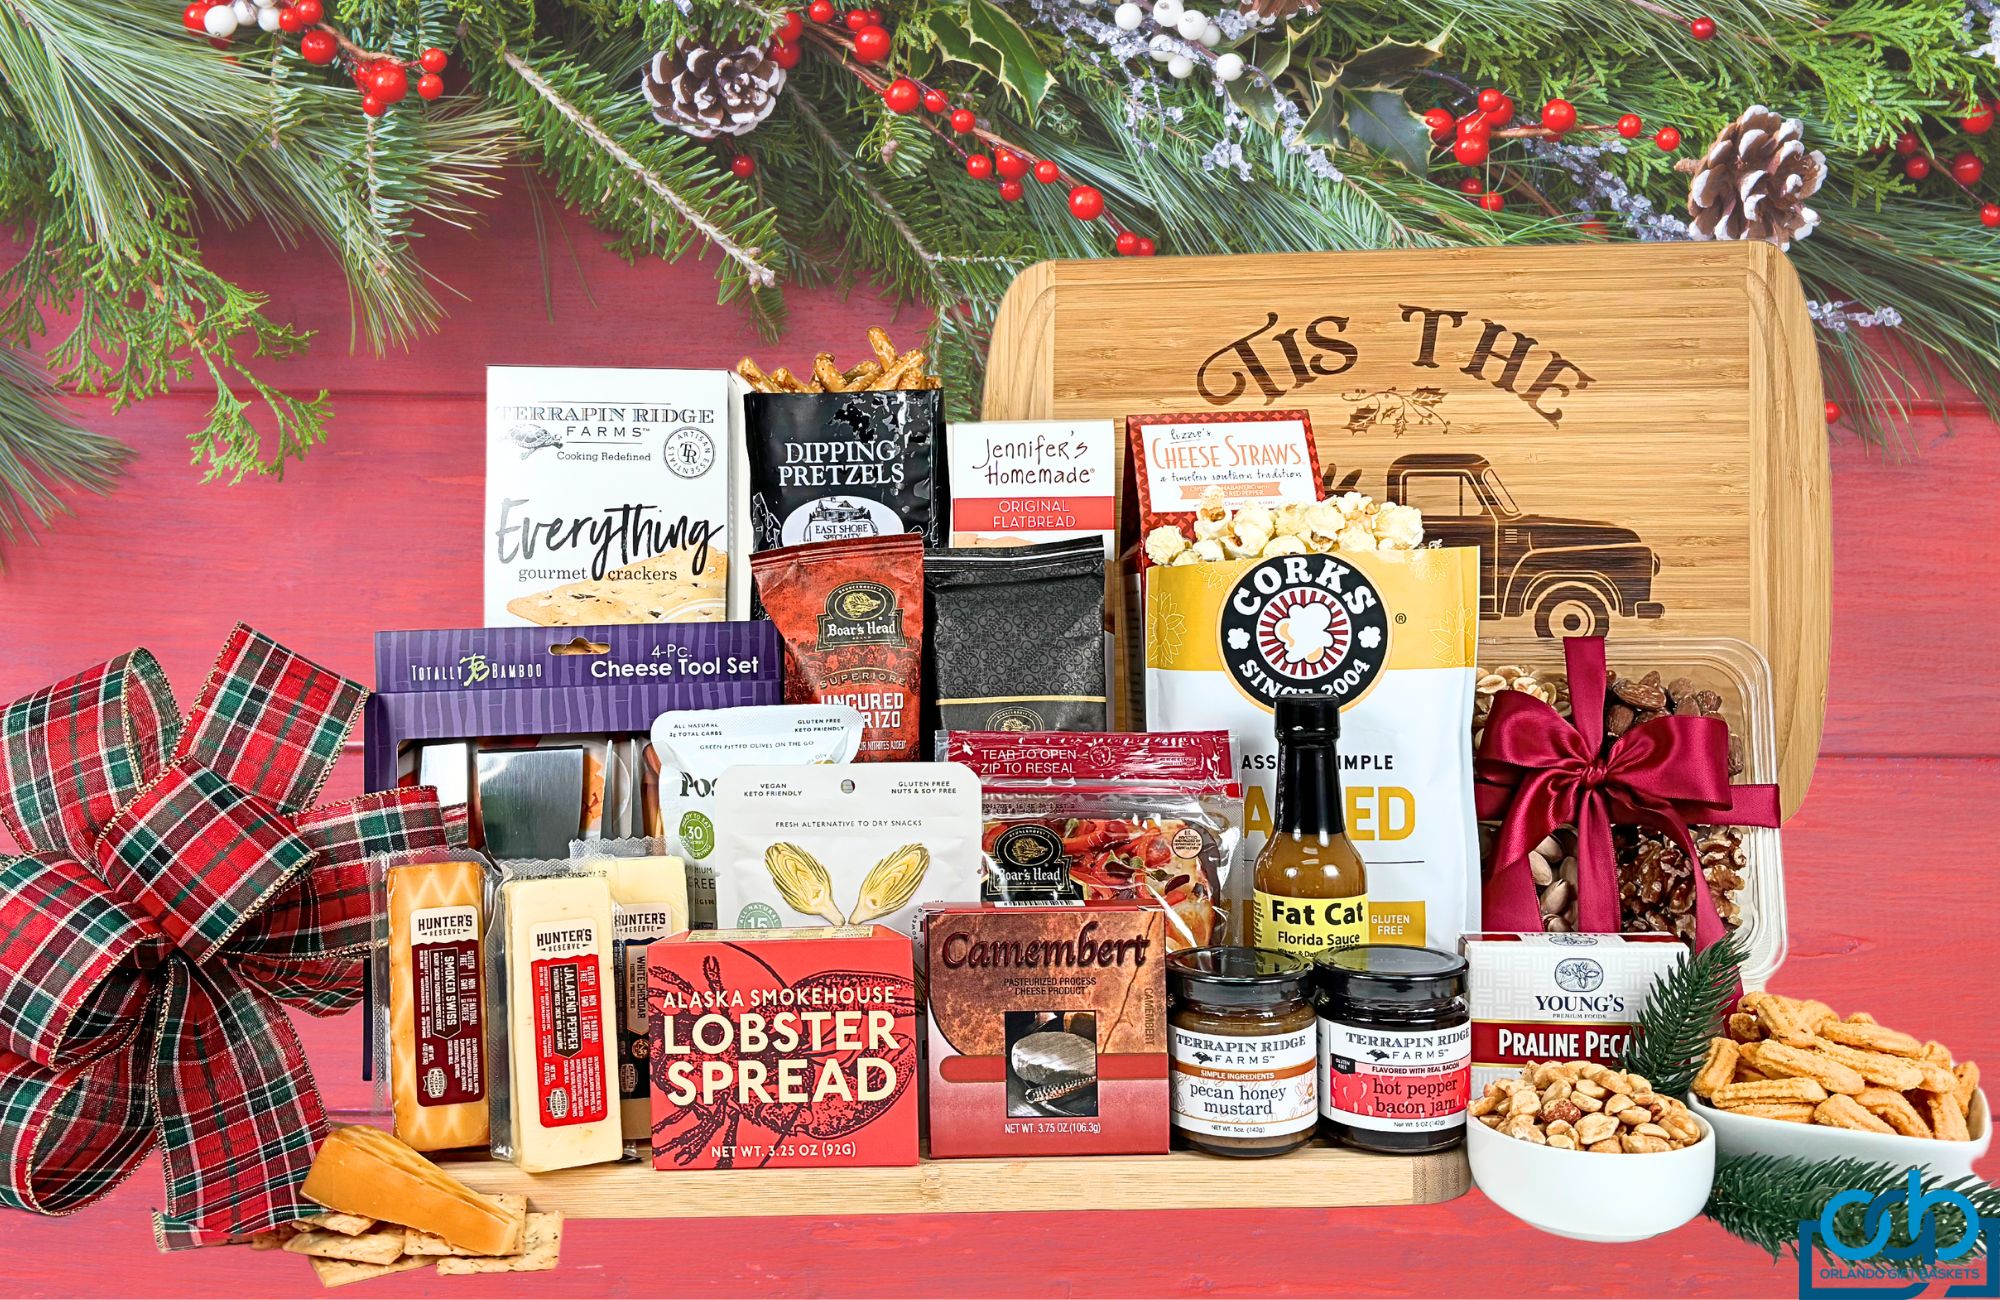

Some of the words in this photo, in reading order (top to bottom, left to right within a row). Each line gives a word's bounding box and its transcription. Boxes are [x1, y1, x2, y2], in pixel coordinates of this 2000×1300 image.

[1398, 303, 1598, 430] THE
[496, 407, 626, 422] TERRAPIN
[632, 408, 714, 423] RIDGE
[676, 431, 711, 454] ARTISAN
[972, 429, 1088, 469] Jennifer's
[557, 451, 598, 462] Cooking
[601, 452, 651, 462] Redefined
[667, 445, 710, 475] ESSENTIALS
[784, 440, 896, 464] DIPPING
[778, 463, 905, 487] PRETZELS
[999, 500, 1069, 513] ORIGINAL
[815, 525, 837, 534] EAST
[839, 524, 868, 533] SHORE
[993, 516, 1076, 529] FLATBREAD
[496, 499, 724, 582] Everything
[518, 567, 588, 582] gourmet
[607, 566, 678, 581] crackers
[1233, 557, 1377, 615] CORKS
[827, 623, 865, 637] Boar's
[866, 620, 896, 635] Head
[651, 644, 692, 660] 4-Pc.
[411, 665, 462, 682] TOTALLY
[492, 663, 542, 680] BAMBOO
[590, 660, 672, 679] Cheese
[678, 658, 721, 676] Tool
[727, 656, 759, 675] Set
[819, 671, 906, 689] SUPERIORE
[820, 693, 904, 710] UNCURED
[981, 750, 1016, 760] TEAR
[1020, 750, 1037, 760] TO
[1039, 750, 1077, 760] OPEN
[980, 763, 1001, 774] ZIP
[1006, 763, 1023, 774] TO
[1025, 762, 1077, 774] RESEAL
[686, 826, 703, 840] 30
[802, 820, 855, 828] ALTERNATIVE
[1033, 867, 1061, 881] Head
[614, 912, 666, 927] HUNTER'S
[1272, 900, 1315, 926] Fat
[1325, 901, 1363, 926] Cat
[1371, 915, 1410, 924] GLUTEN
[418, 914, 473, 931] HUNTER'S
[624, 925, 655, 933] RESERVE
[1377, 926, 1403, 935] FREE
[537, 928, 592, 947] HUNTER'S
[941, 921, 1150, 969] Camembert
[1278, 931, 1323, 946] Florida
[1327, 934, 1360, 946] Sauce
[548, 944, 580, 952] RESERVE
[444, 956, 456, 993] SMOKED
[636, 955, 646, 980] WHITE
[1003, 978, 1057, 986] PASTEURIZED
[1059, 977, 1097, 986] PROCESS
[1015, 987, 1046, 995] CHEESE
[1049, 986, 1086, 995] PRODUCT
[663, 989, 744, 1009] ALASKA
[1535, 994, 1624, 1012] YOUNG'S
[445, 995, 457, 1026] SWISS
[1144, 987, 1155, 1046] CAMEMBERT
[567, 1015, 578, 1050] PEPPER
[663, 1010, 901, 1055] LOBSTER
[1345, 1032, 1434, 1048] TERRAPIN
[1437, 1027, 1470, 1046] RIDGE
[1175, 1033, 1258, 1052] TERRAPIN
[1260, 1035, 1306, 1051] RIDGE
[1498, 1028, 1580, 1058] PRALINE
[1200, 1070, 1226, 1080] SIMPLE
[1372, 1066, 1407, 1075] FLAVORED
[1427, 1065, 1441, 1073] REAL
[1442, 1062, 1460, 1071] BACON
[666, 1057, 897, 1106] SPREAD
[1373, 1078, 1401, 1095] hot
[1403, 1079, 1458, 1098] pepper
[1190, 1083, 1234, 1100] pecan
[1238, 1085, 1286, 1101] honey
[1204, 1100, 1273, 1115] mustard
[1375, 1096, 1426, 1114] bacon
[1429, 1097, 1456, 1116] jam
[1004, 1124, 1021, 1133] NET
[1022, 1124, 1036, 1133] WT.
[1038, 1123, 1055, 1133] 3.75
[711, 1145, 737, 1158] NET
[741, 1145, 765, 1157] WT.
[768, 1144, 795, 1157] 3.25
[798, 1144, 819, 1157] OZ
[822, 1142, 856, 1158] (92G)
